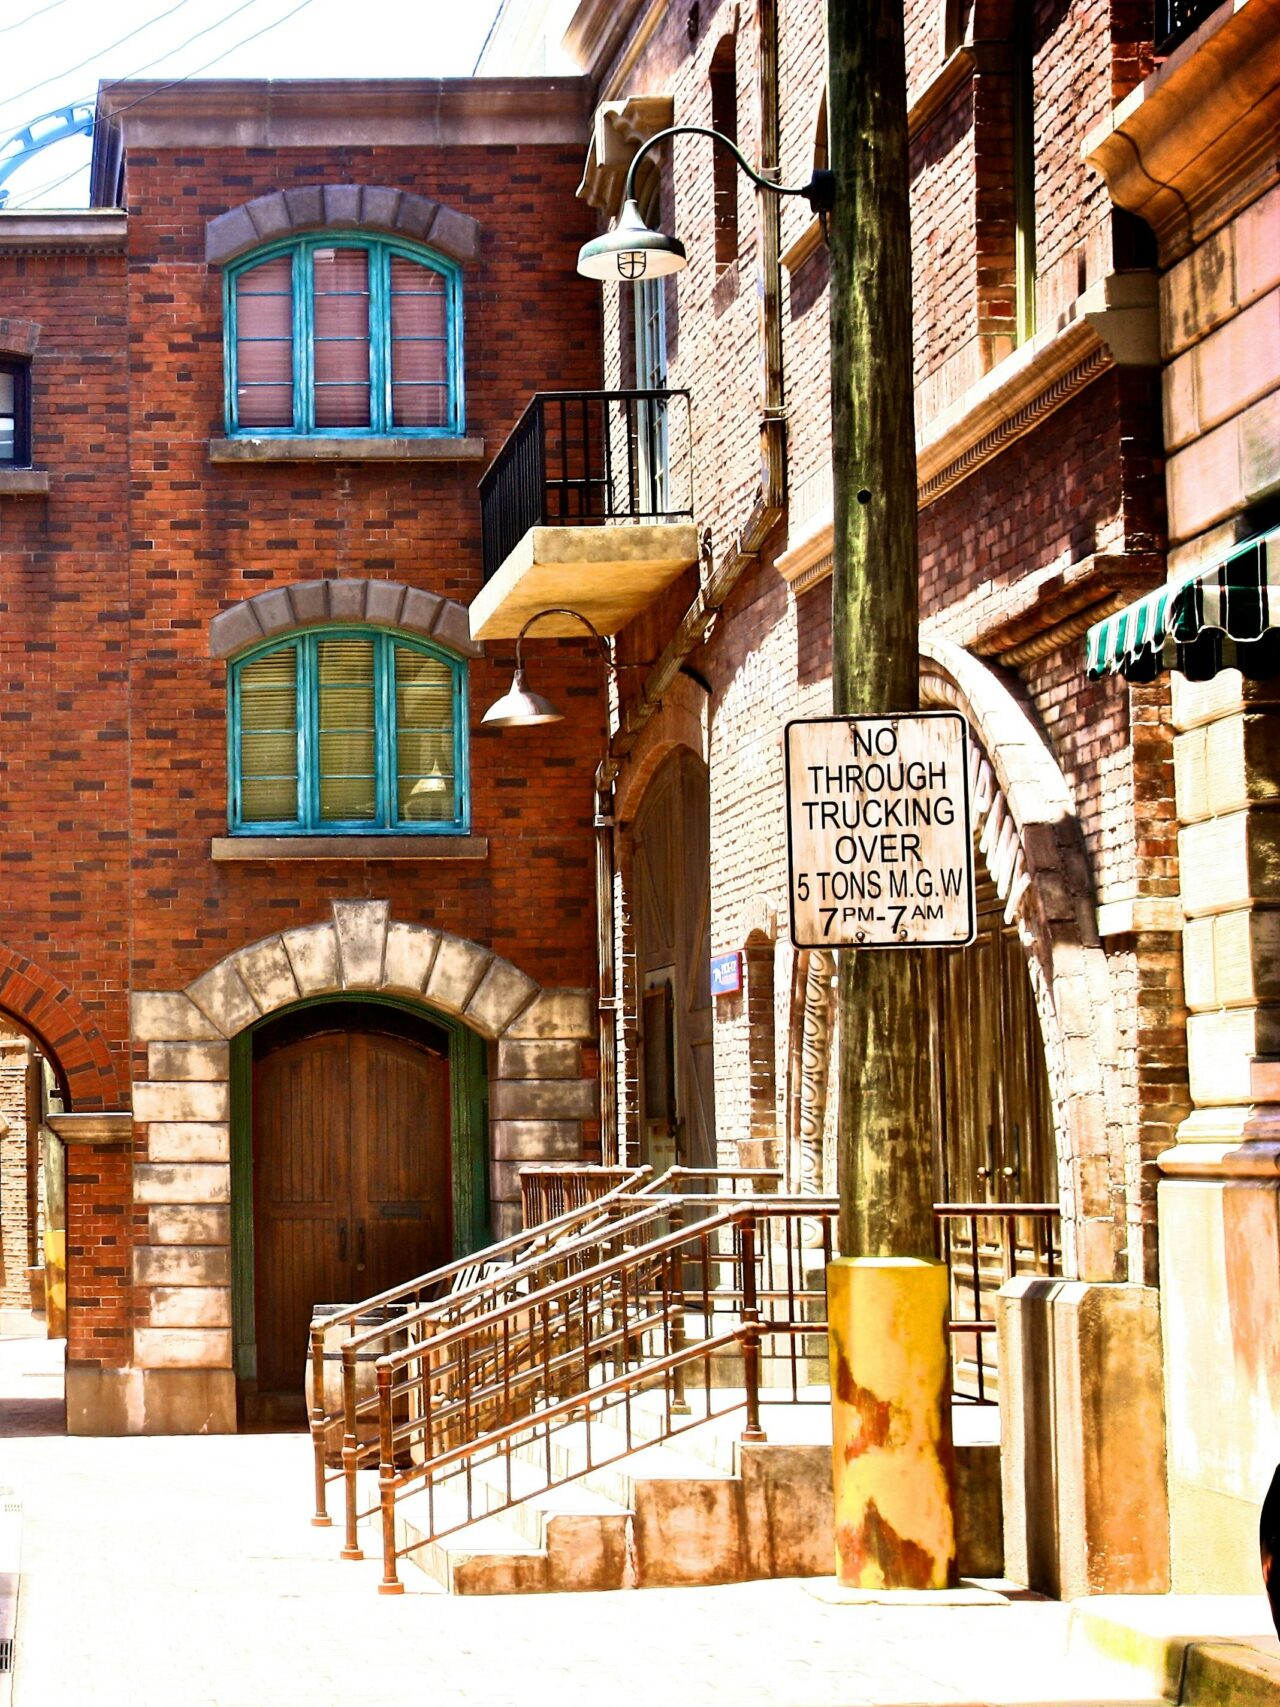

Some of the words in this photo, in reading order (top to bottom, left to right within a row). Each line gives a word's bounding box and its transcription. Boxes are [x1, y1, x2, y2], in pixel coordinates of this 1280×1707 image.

[853, 727, 898, 757] NO
[807, 761, 947, 794] THROUGH
[802, 796, 955, 830] TRUCKING
[835, 833, 922, 865] OVER
[969, 739, 1032, 926] PANY
[797, 873, 810, 901] 5
[816, 870, 882, 901] TONS
[889, 868, 963, 898] M.G.W
